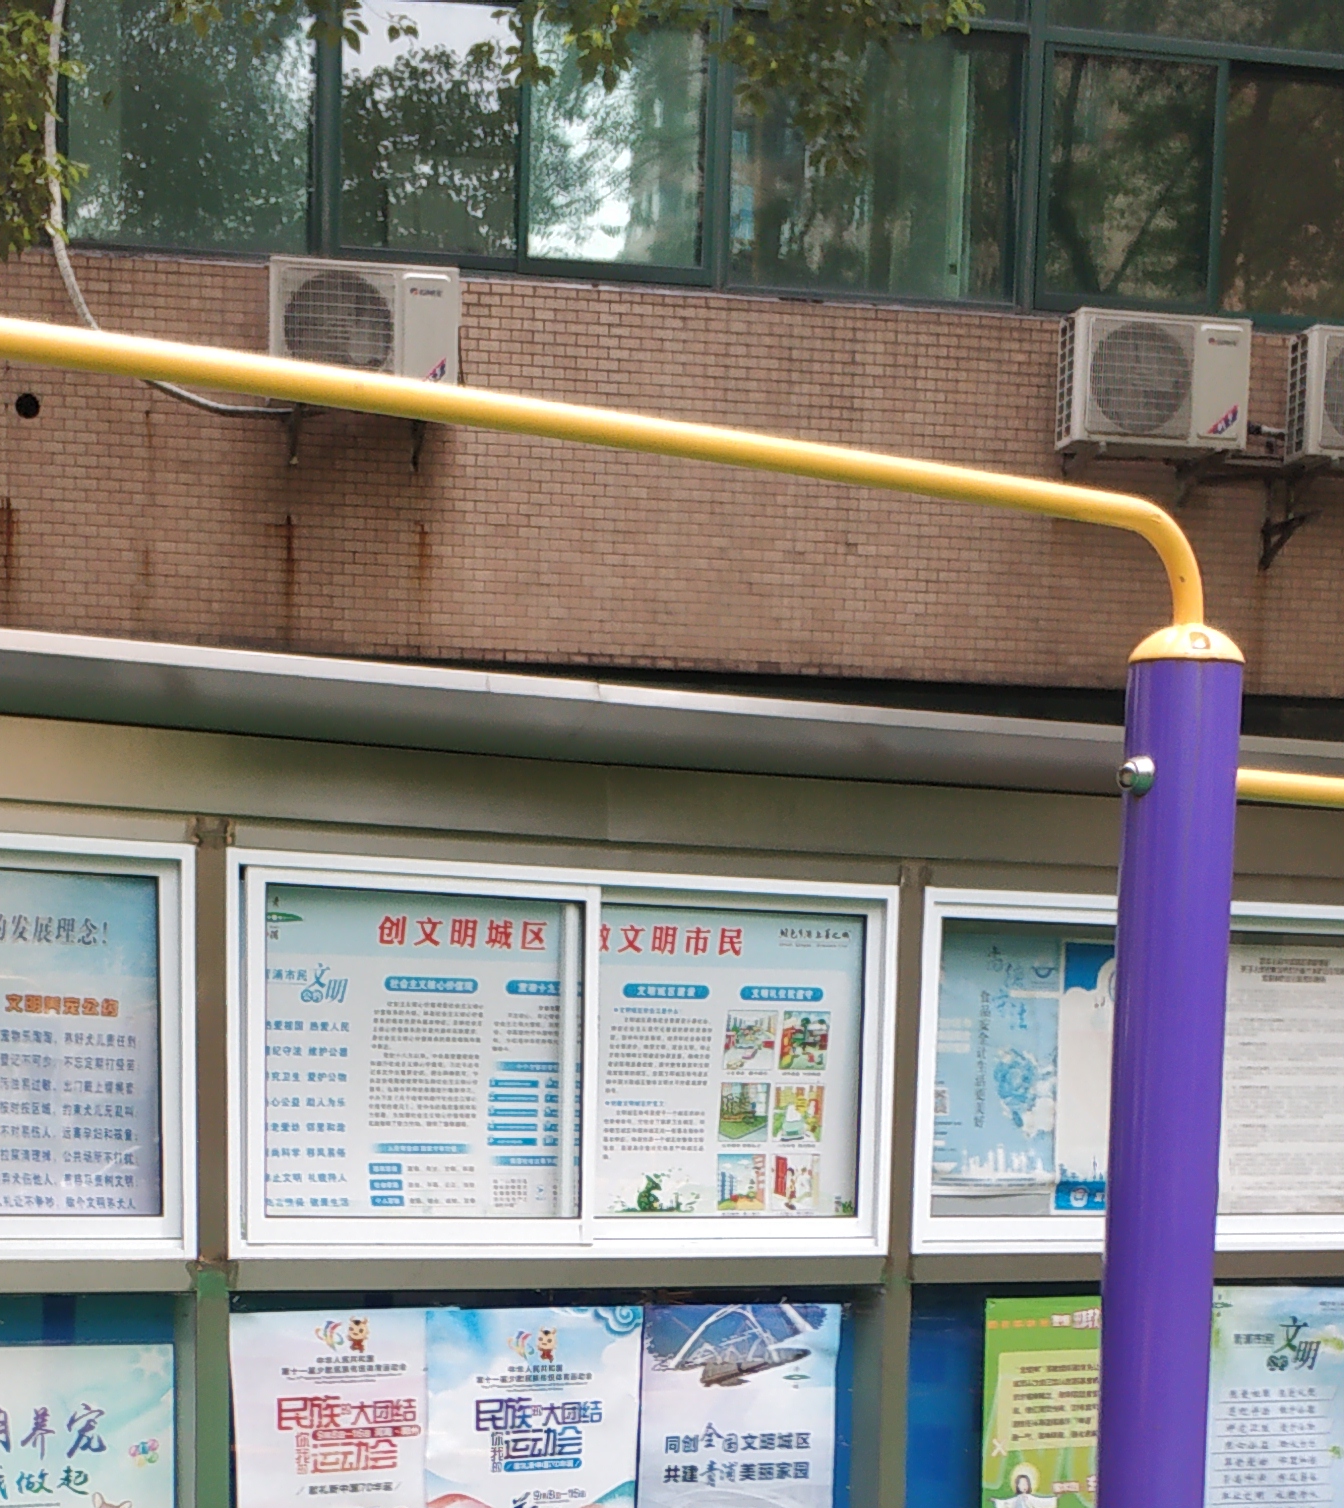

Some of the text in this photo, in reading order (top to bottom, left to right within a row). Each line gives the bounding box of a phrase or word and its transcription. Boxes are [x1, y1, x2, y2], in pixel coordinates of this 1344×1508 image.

[378, 915, 548, 951] 创文明城区
[311, 1438, 398, 1474] 运动会
[504, 1425, 583, 1460] 运动会
[662, 1460, 811, 1488] 共建青浦美丽家园
